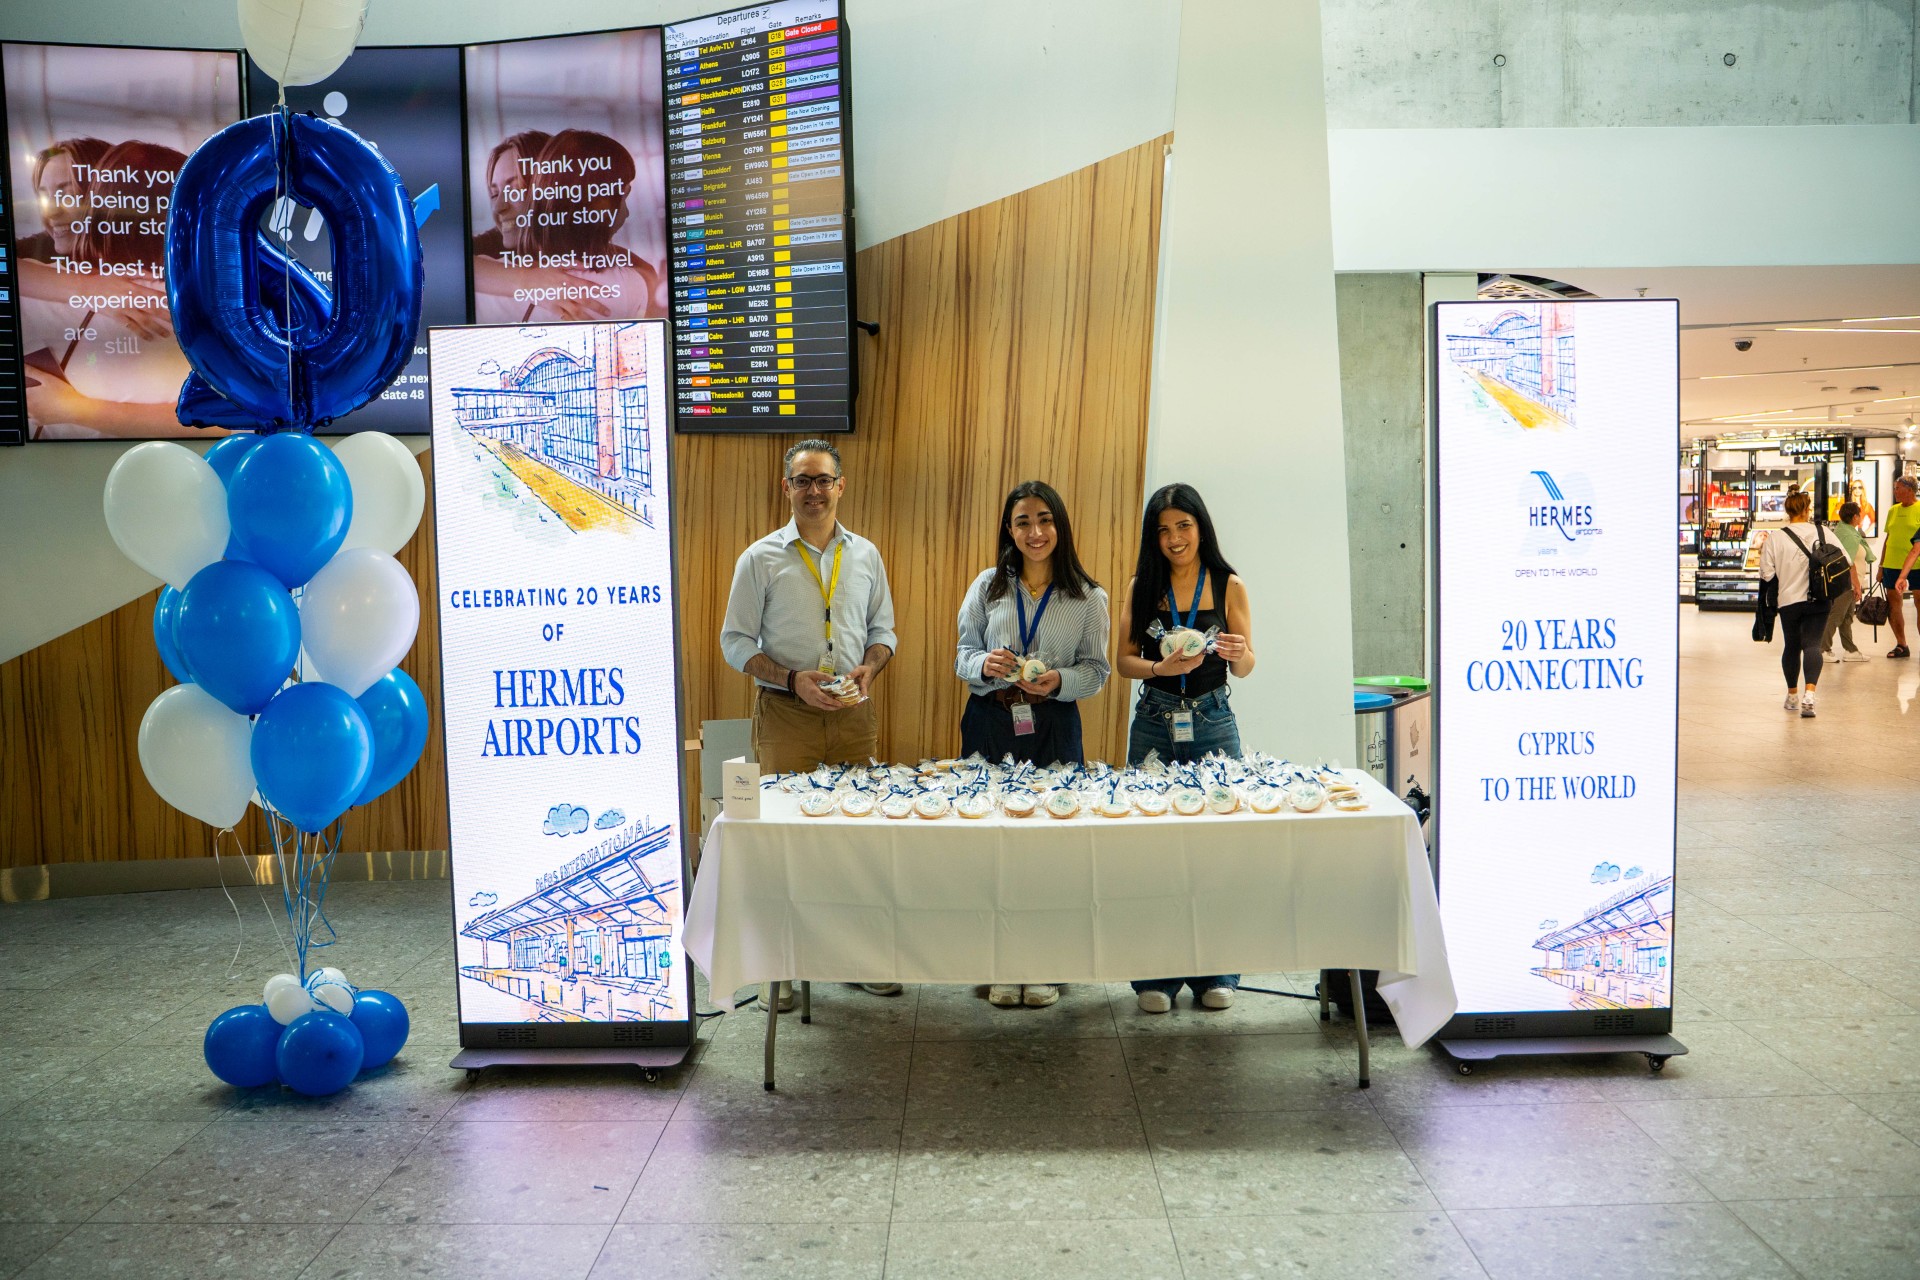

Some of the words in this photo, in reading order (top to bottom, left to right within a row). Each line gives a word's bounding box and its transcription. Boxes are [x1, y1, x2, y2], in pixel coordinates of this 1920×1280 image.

[718, 10, 759, 26] Departures
[796, 13, 821, 23] Remarks
[699, 32, 729, 44] Destination
[708, 42, 734, 53] Aviv-TLV
[785, 28, 799, 37] Gate
[801, 24, 821, 34] Closed
[741, 26, 755, 35] Flight
[682, 37, 698, 47] Airline
[700, 60, 718, 70] Athens
[701, 75, 722, 85] Warsaw
[742, 68, 759, 77] LO172
[702, 120, 726, 130] Frankfurt
[702, 136, 725, 146] Salzburg
[703, 152, 721, 161] Vienna
[72, 164, 139, 184] Thank
[518, 155, 574, 176] Thank
[578, 156, 611, 176] you
[703, 166, 731, 176] Dusseldorf
[503, 185, 527, 202] for
[532, 182, 582, 203] being
[587, 178, 624, 202] part
[704, 182, 727, 192] Belgrade
[54, 190, 83, 208] for
[90, 190, 150, 213] being
[704, 197, 726, 206] Yerevan
[516, 209, 533, 227] of
[538, 212, 567, 226] our
[572, 207, 618, 227] story
[705, 213, 723, 221] Munich
[71, 217, 92, 234] of
[98, 221, 130, 234] our
[139, 220, 166, 235] sto
[746, 224, 764, 232] CY312
[51, 257, 92, 274] The
[99, 258, 146, 276] best
[500, 251, 533, 268] The
[538, 250, 577, 267] best
[582, 249, 633, 269] travel
[707, 272, 734, 280] Dusseldorf
[69, 291, 169, 312] experienc
[514, 282, 620, 305] experiences
[64, 327, 97, 341] are
[105, 337, 141, 354] still
[410, 374, 428, 384] nex
[381, 390, 407, 400] Gate
[410, 390, 424, 399] 48
[1784, 441, 1838, 453] CHANEL
[1530, 506, 1592, 541] HERMES
[1515, 569, 1536, 577] OPEN
[1568, 568, 1597, 576] WORLD
[451, 588, 567, 608] CELEBRATING
[576, 586, 598, 605] 20
[608, 585, 661, 605] YEARS
[542, 624, 564, 641] OF
[1502, 620, 1528, 651] 20
[1535, 618, 1617, 650] YEARS
[1466, 657, 1644, 692] CONNECTING
[493, 667, 625, 708] HERMES
[481, 716, 642, 758] AIRPORTS
[1518, 730, 1595, 756] CYPRUS
[1481, 777, 1509, 801] TO
[1516, 776, 1556, 801] THE
[1563, 775, 1636, 799] WORLD
[536, 871, 558, 892] PAFOS
[560, 815, 656, 880] INTERNATIONAL
